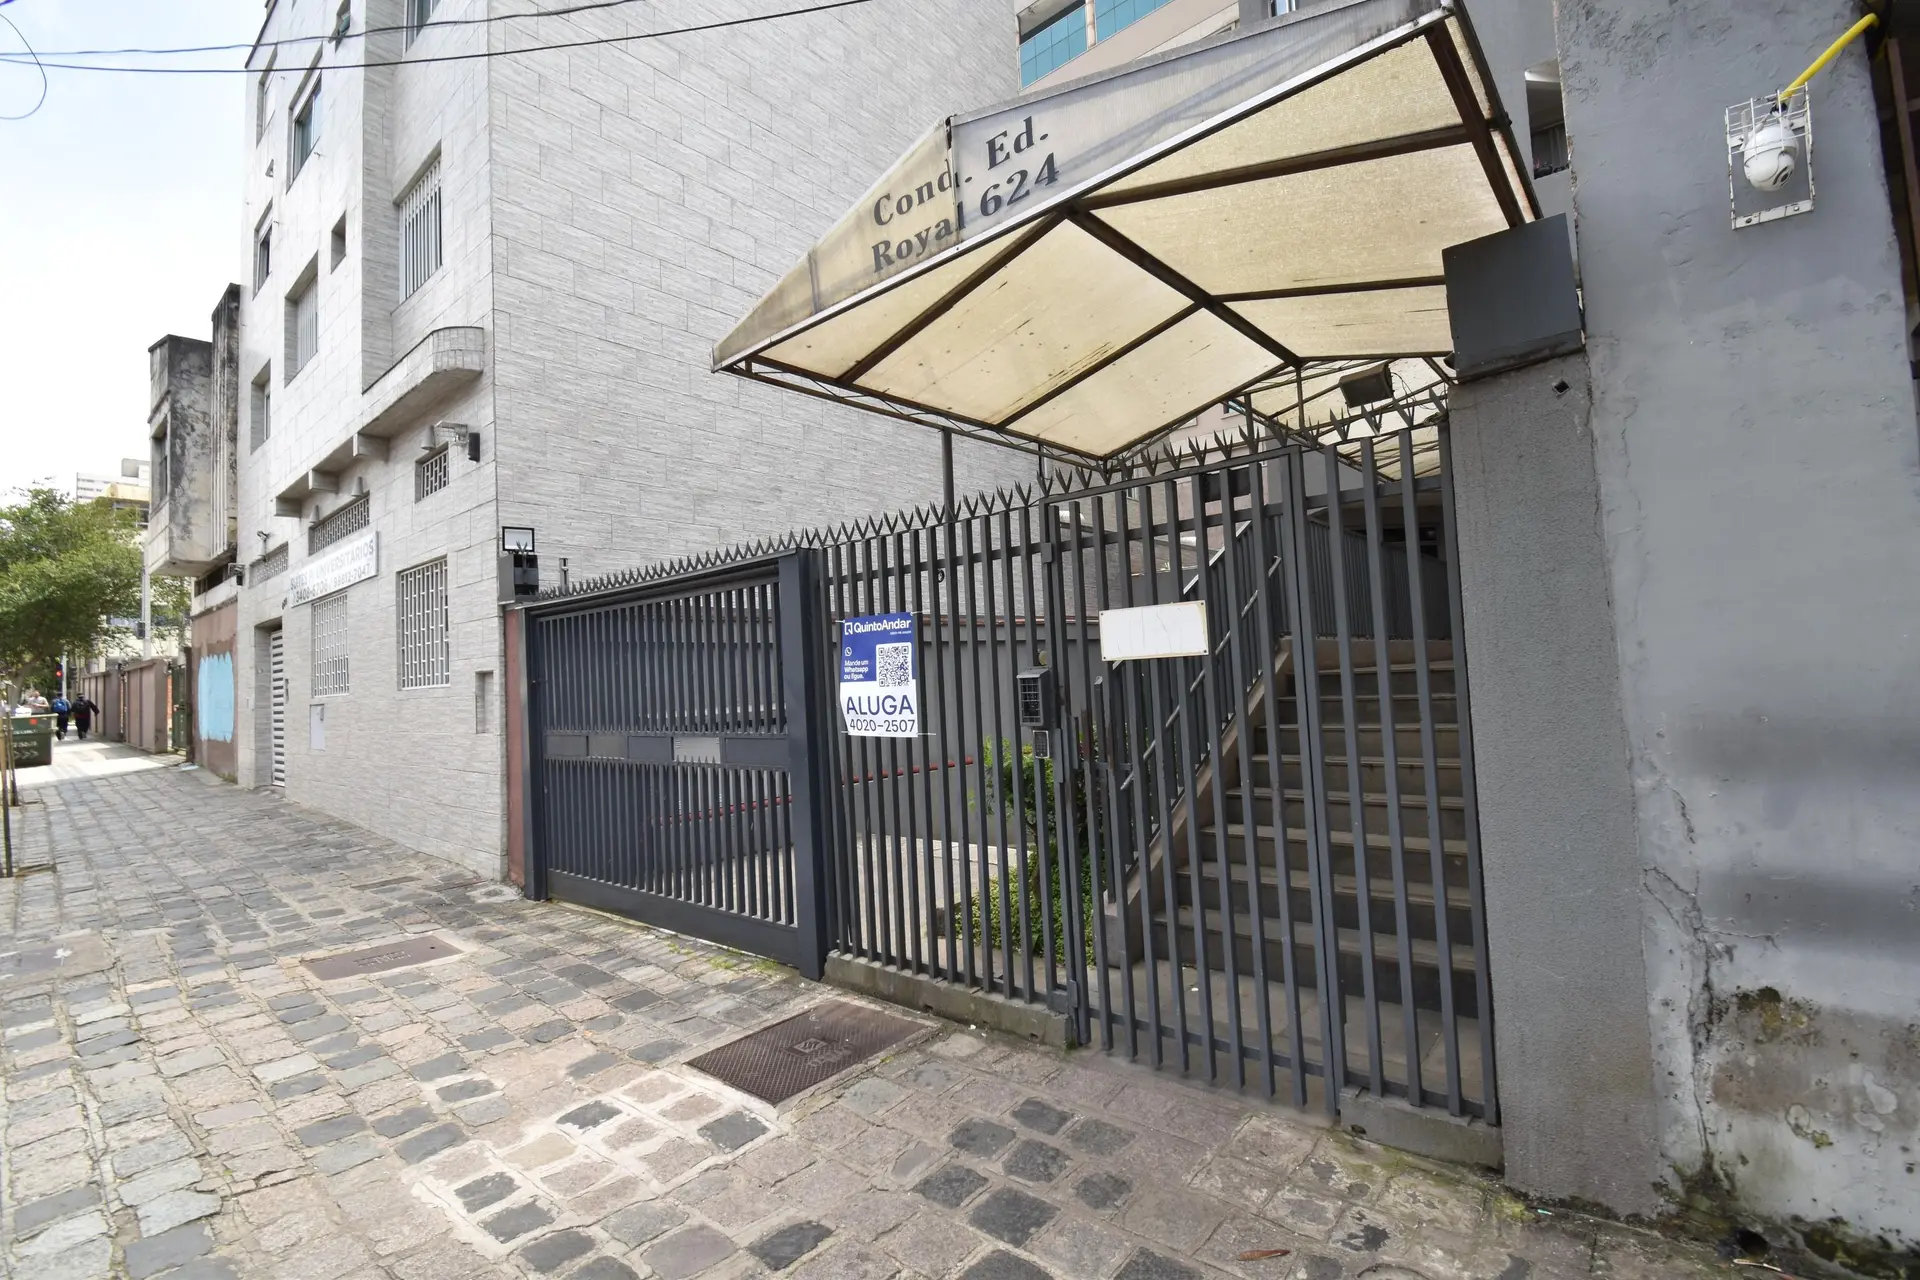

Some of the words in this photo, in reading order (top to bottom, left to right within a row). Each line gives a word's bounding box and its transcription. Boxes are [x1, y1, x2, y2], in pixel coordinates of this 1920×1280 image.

[873, 158, 973, 226] Cond.
[985, 115, 1049, 171] Ed.
[871, 200, 966, 273] Royal
[979, 152, 1060, 217] 624
[853, 618, 912, 634] QuintoAndar
[846, 695, 914, 716] ALUGA
[849, 718, 915, 733] 4020-2507
